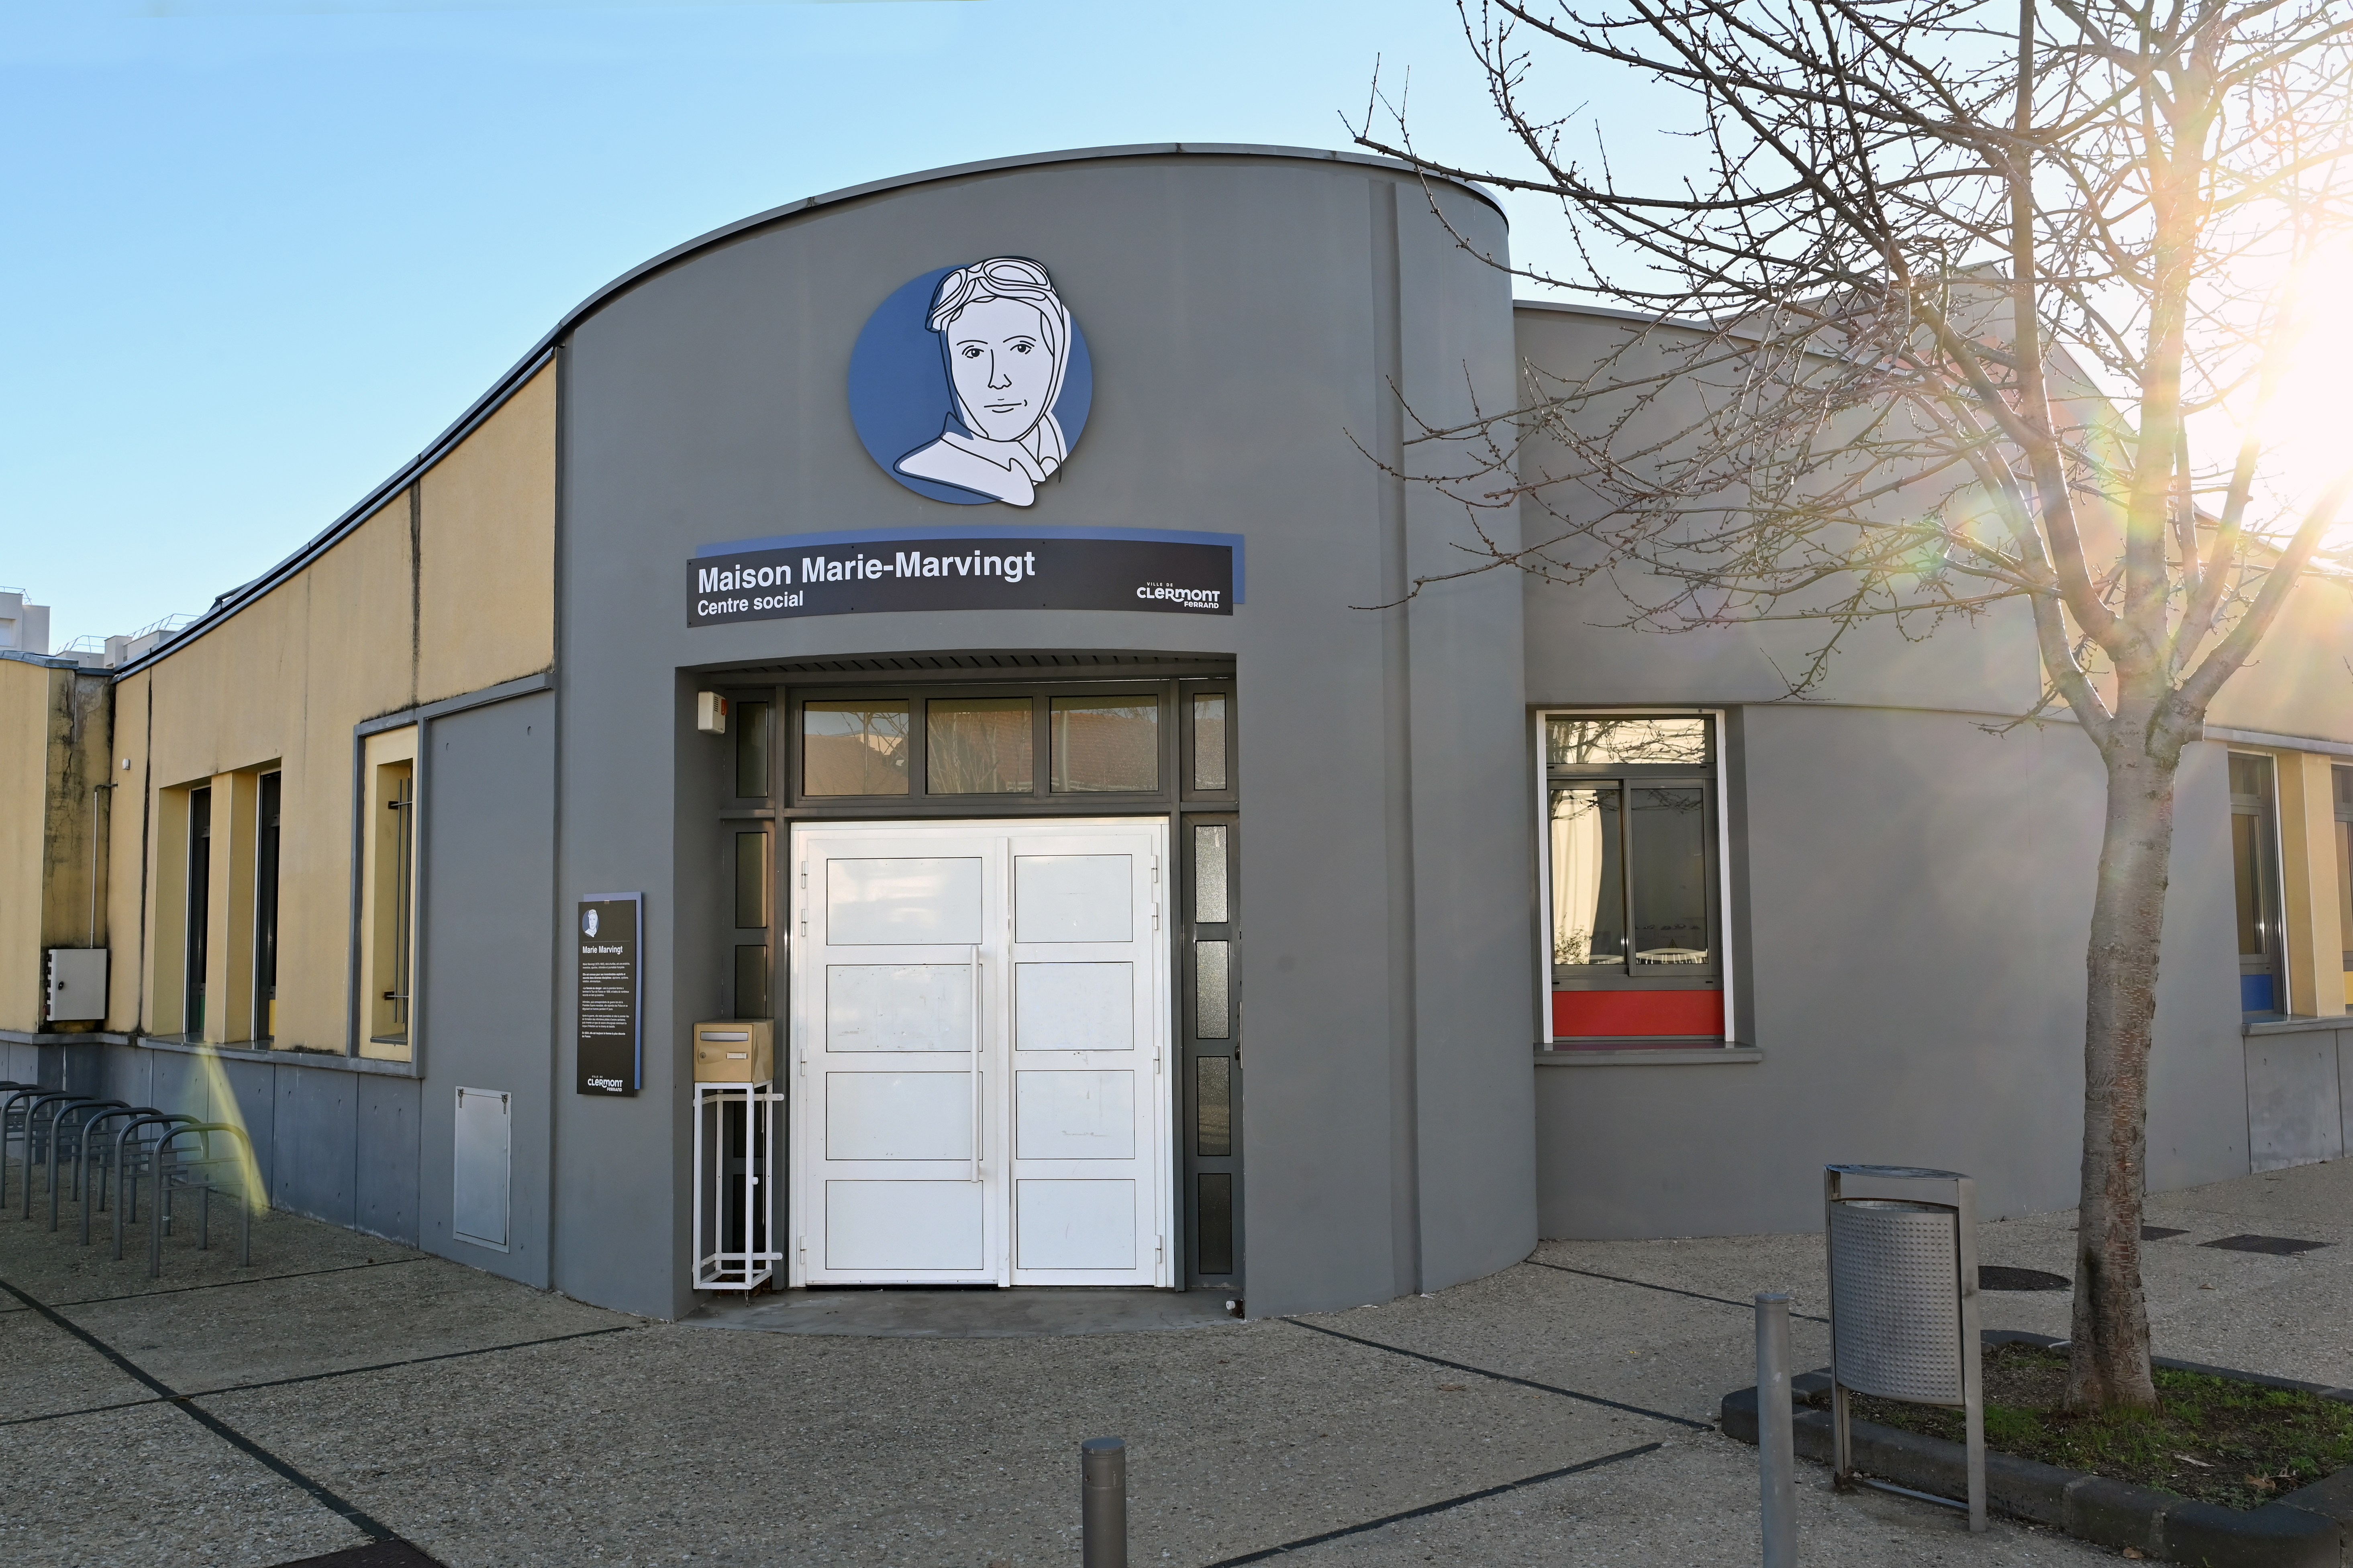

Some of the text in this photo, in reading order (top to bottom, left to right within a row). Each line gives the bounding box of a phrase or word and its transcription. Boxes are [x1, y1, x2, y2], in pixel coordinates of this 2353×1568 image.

[698, 550, 1035, 593] Maison Marie-Marvingt
[698, 590, 803, 616] Centre social
[582, 945, 623, 955] Marie Marvingt
